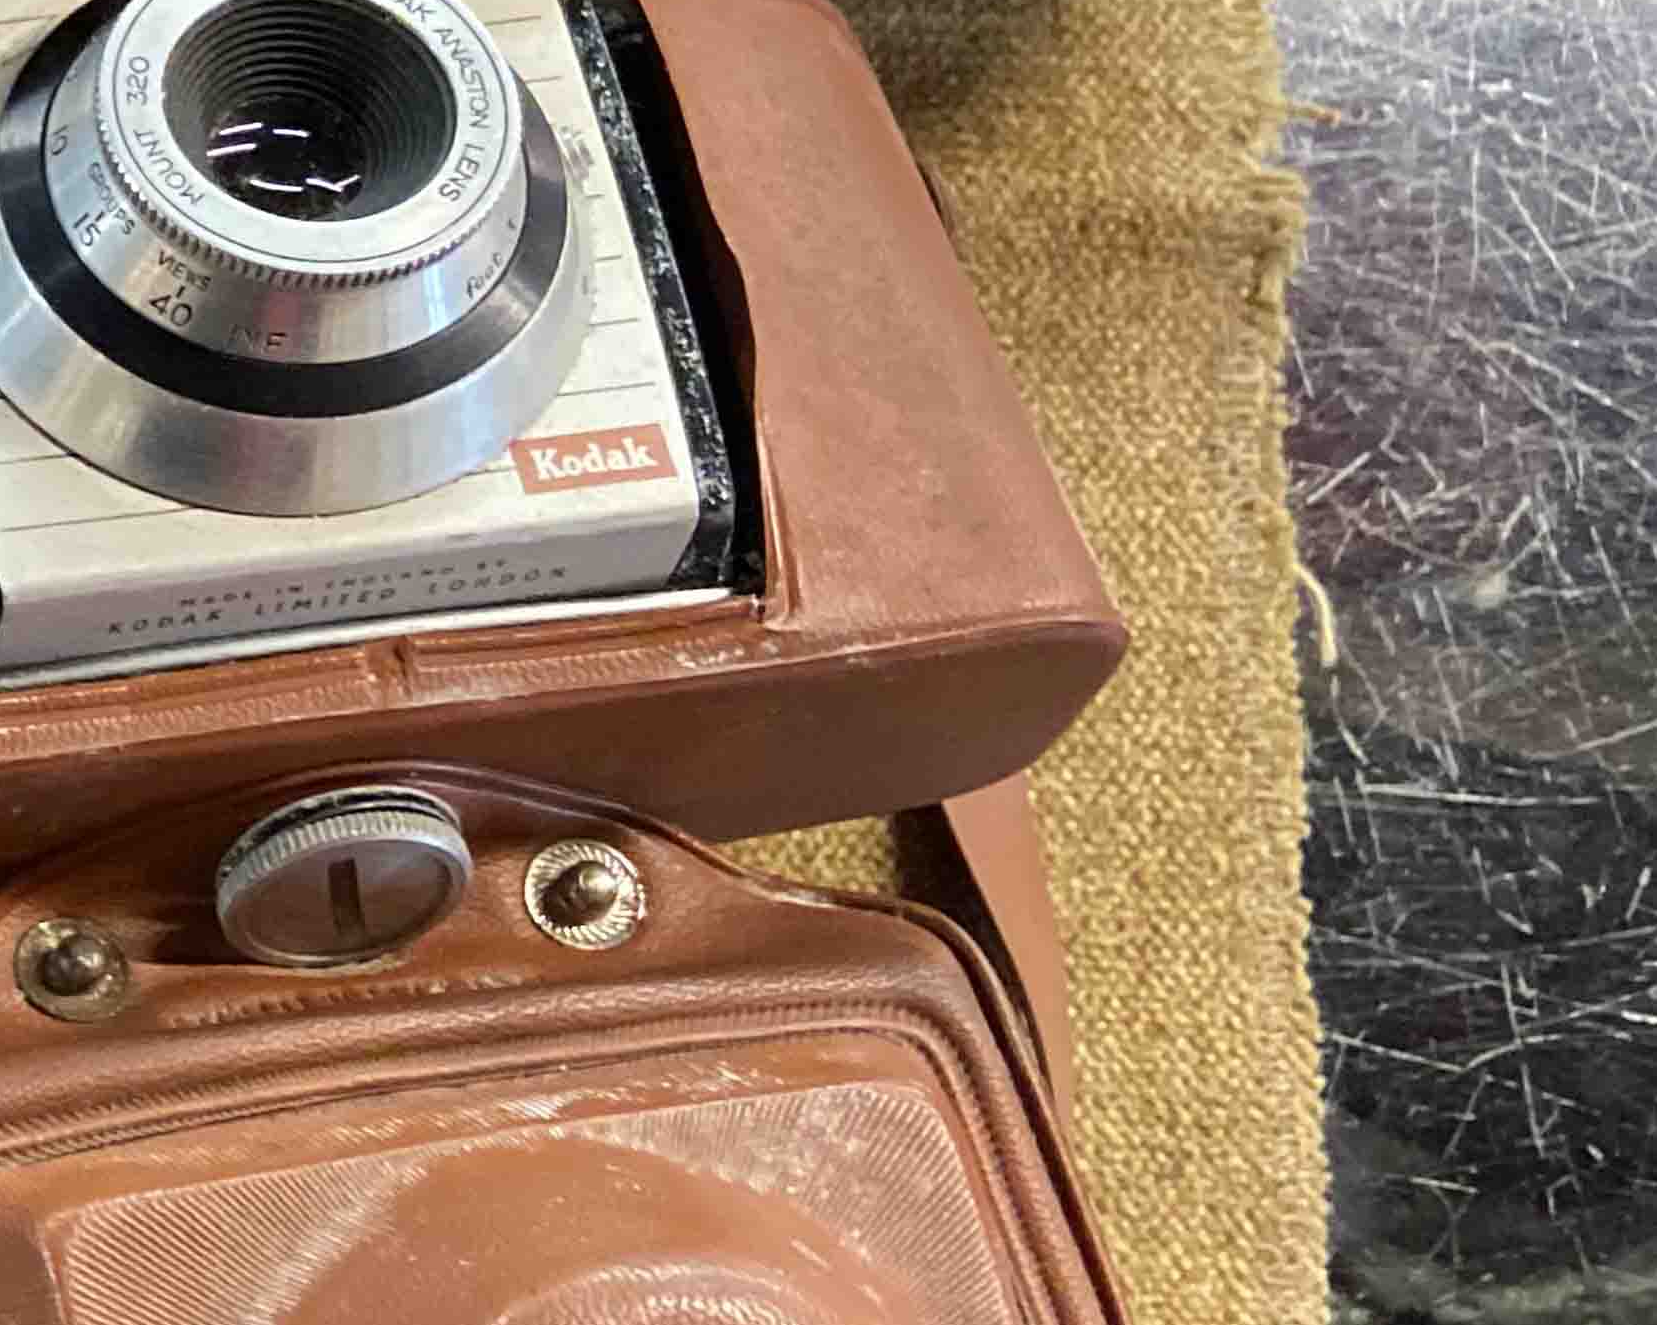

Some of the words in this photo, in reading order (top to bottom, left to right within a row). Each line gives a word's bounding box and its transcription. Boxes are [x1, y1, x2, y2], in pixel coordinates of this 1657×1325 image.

[125, 55, 151, 108] 320
[431, 27, 490, 130] ANASTON
[134, 128, 206, 205] MOUNT
[438, 142, 486, 203] LENS
[72, 212, 103, 248] 15
[157, 249, 212, 292] VIEWS
[148, 294, 194, 328] 40
[529, 435, 661, 482] Kodak
[107, 608, 223, 635] KODAK
[254, 587, 396, 616] LIMITED
[427, 566, 567, 596] LONDON
